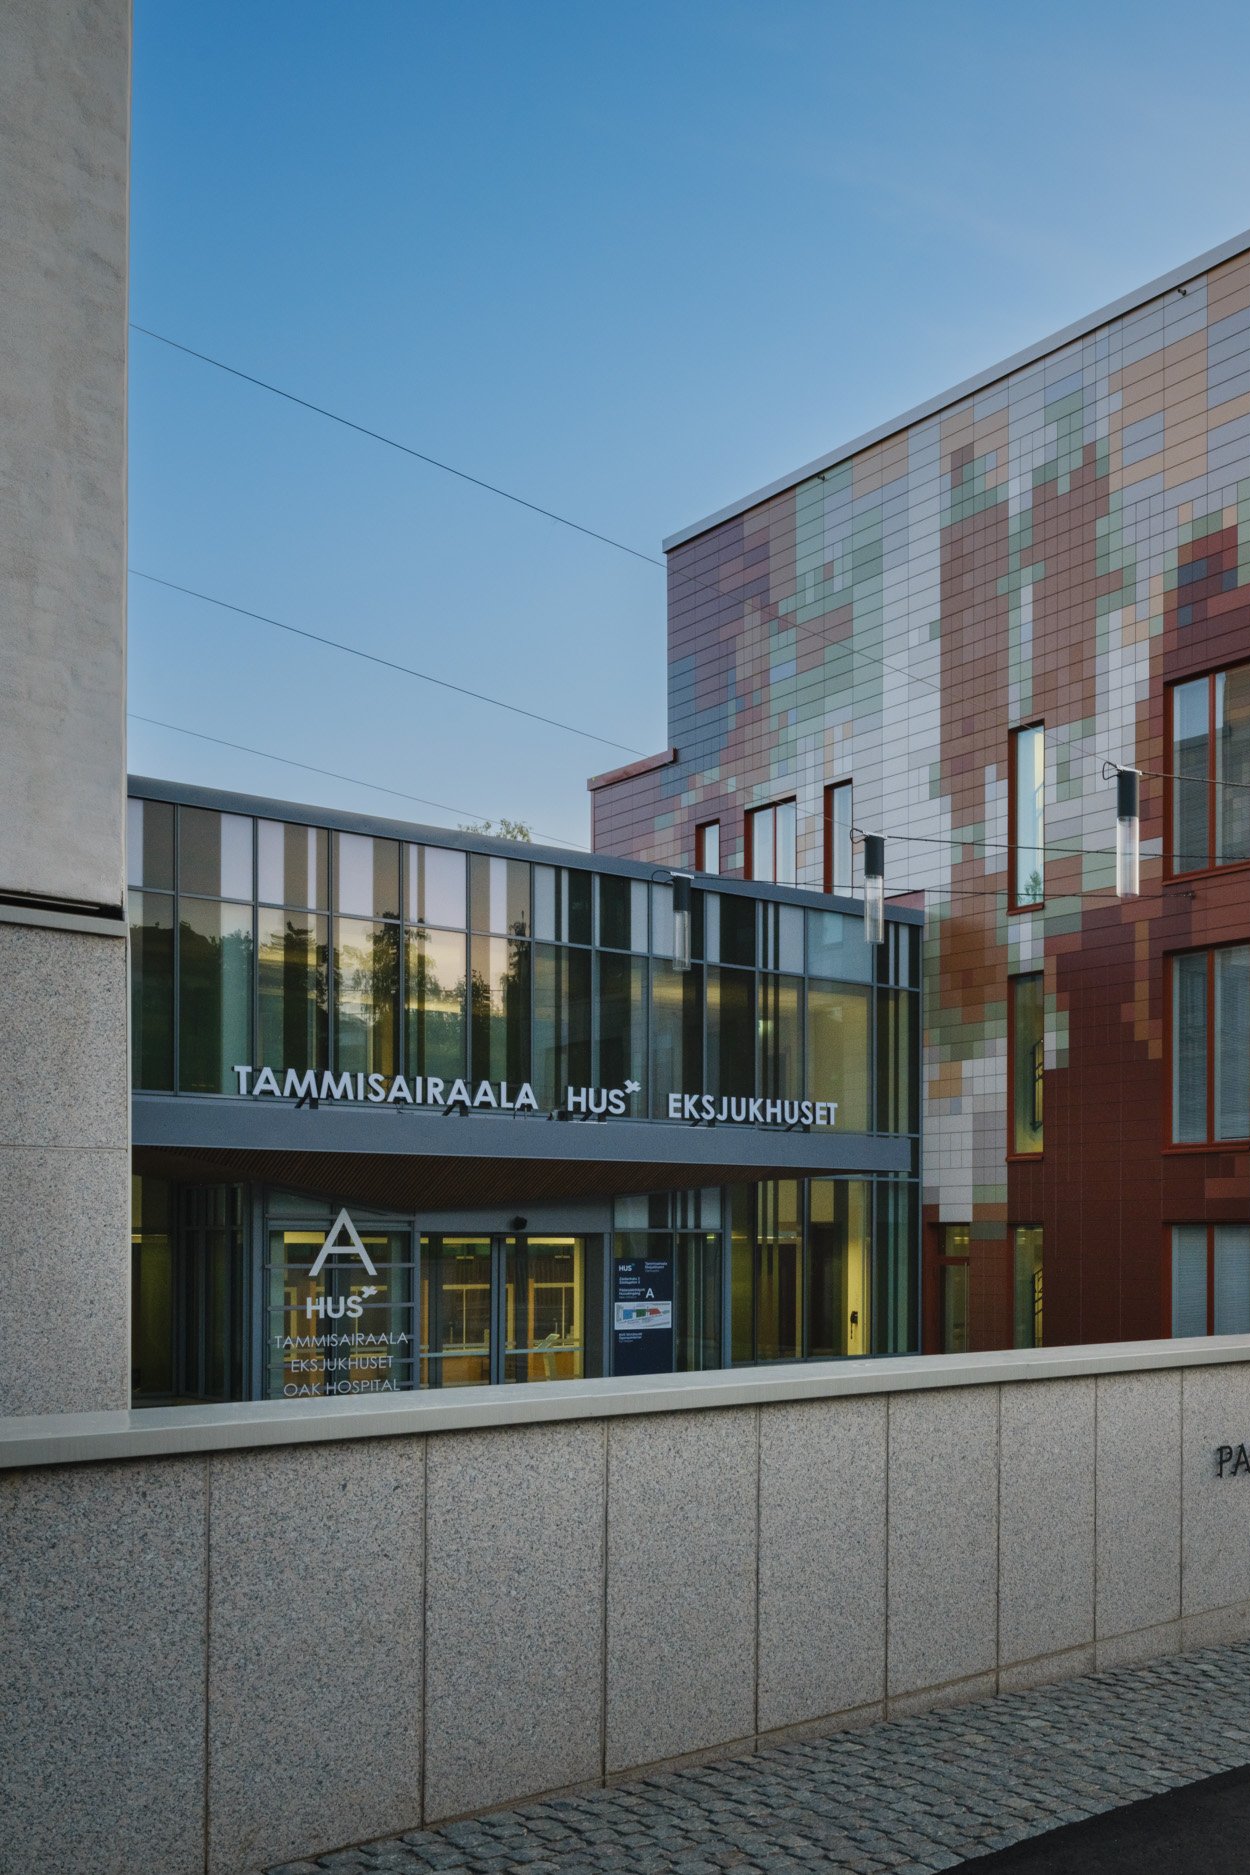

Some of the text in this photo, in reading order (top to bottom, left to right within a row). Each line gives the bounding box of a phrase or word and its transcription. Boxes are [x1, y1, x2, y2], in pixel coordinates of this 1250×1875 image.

[234, 1065, 838, 1126] TAMMISAIRAALA HUS EKSJUKHUSET
[308, 1207, 378, 1277] A
[646, 1288, 654, 1298] A
[306, 1295, 364, 1319] HUS
[274, 1332, 409, 1349] TAMMISAIRAALA
[291, 1356, 394, 1373] EKSJUKHUSET
[283, 1379, 400, 1397] OAK HOSPITAL
